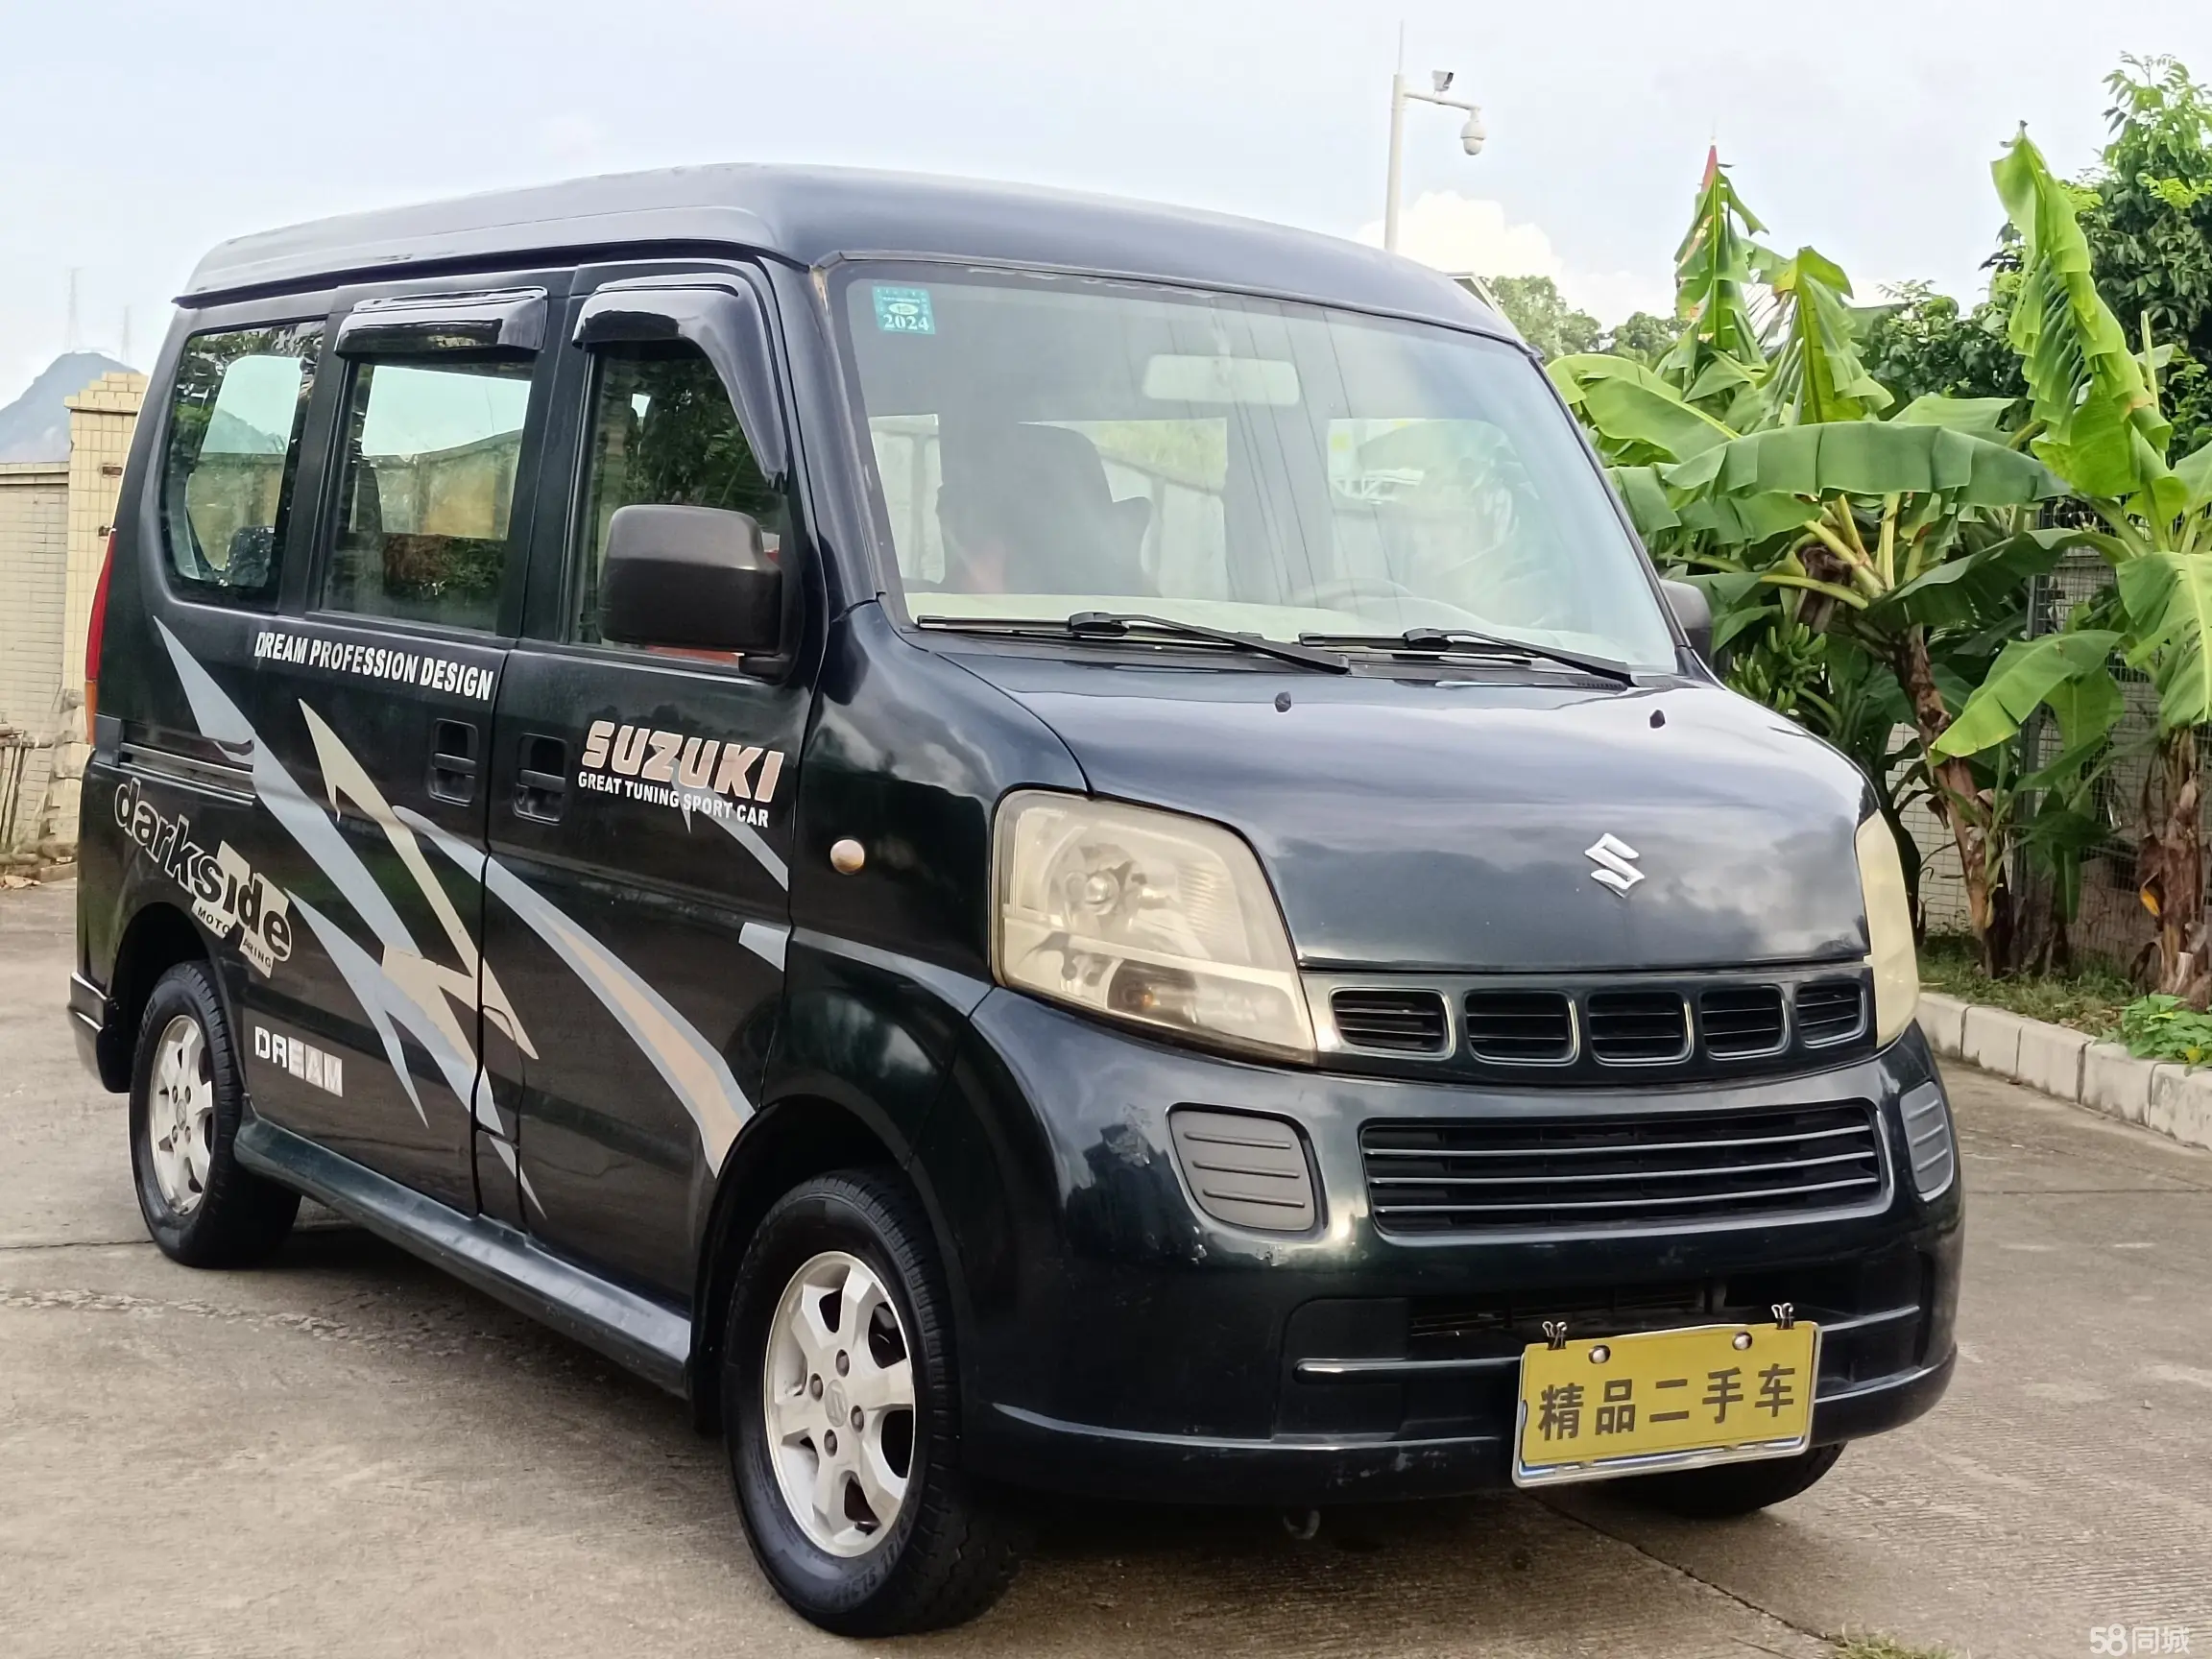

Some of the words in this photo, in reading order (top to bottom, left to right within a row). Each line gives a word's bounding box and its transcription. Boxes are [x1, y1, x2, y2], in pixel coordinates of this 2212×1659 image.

[882, 313, 929, 331] 2024
[254, 632, 308, 664] DREAM
[309, 639, 419, 684] PROFESSION
[420, 657, 494, 701] DESIGN
[581, 720, 785, 804] SUZUKI
[578, 771, 622, 795] GREAT
[624, 781, 680, 808] TUNING
[683, 793, 733, 820] SPORT
[735, 805, 769, 829] CAR
[254, 1025, 344, 1098] DREAM
[1537, 1362, 1796, 1442] 精品二手车
